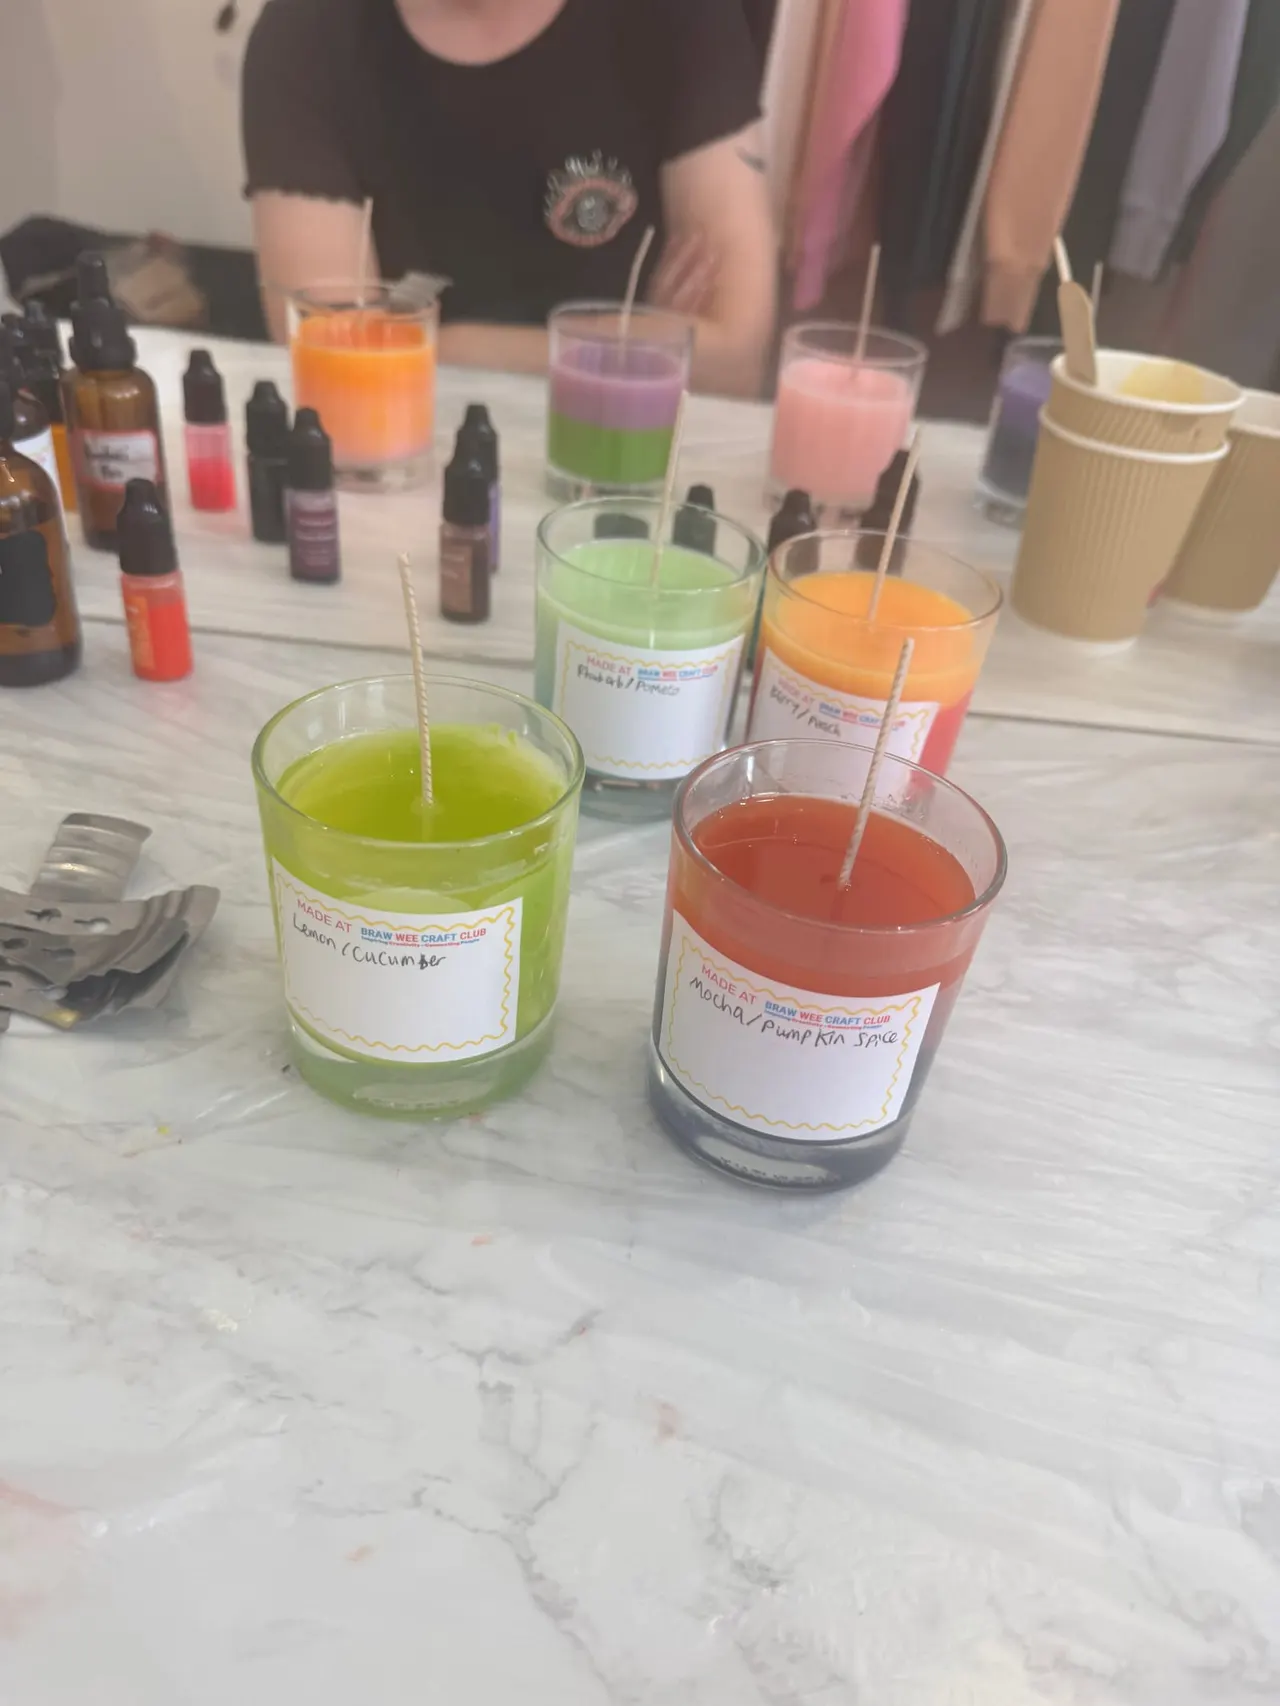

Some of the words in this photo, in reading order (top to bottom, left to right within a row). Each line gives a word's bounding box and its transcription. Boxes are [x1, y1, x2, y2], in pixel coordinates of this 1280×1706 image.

[587, 655, 616, 672] MADE
[618, 665, 632, 675] AT
[297, 900, 332, 925] MADE
[335, 920, 352, 933] AT
[361, 927, 393, 940] BRAW
[395, 933, 418, 943] WEE
[421, 933, 458, 943] CRAFT
[460, 928, 487, 940] CLUB
[702, 965, 737, 995] MADE
[739, 991, 757, 1005] AT
[765, 1001, 797, 1017] BRAW
[799, 1011, 822, 1023] WEE
[825, 1015, 862, 1026] CRAFT
[863, 1015, 891, 1025] CLUB
